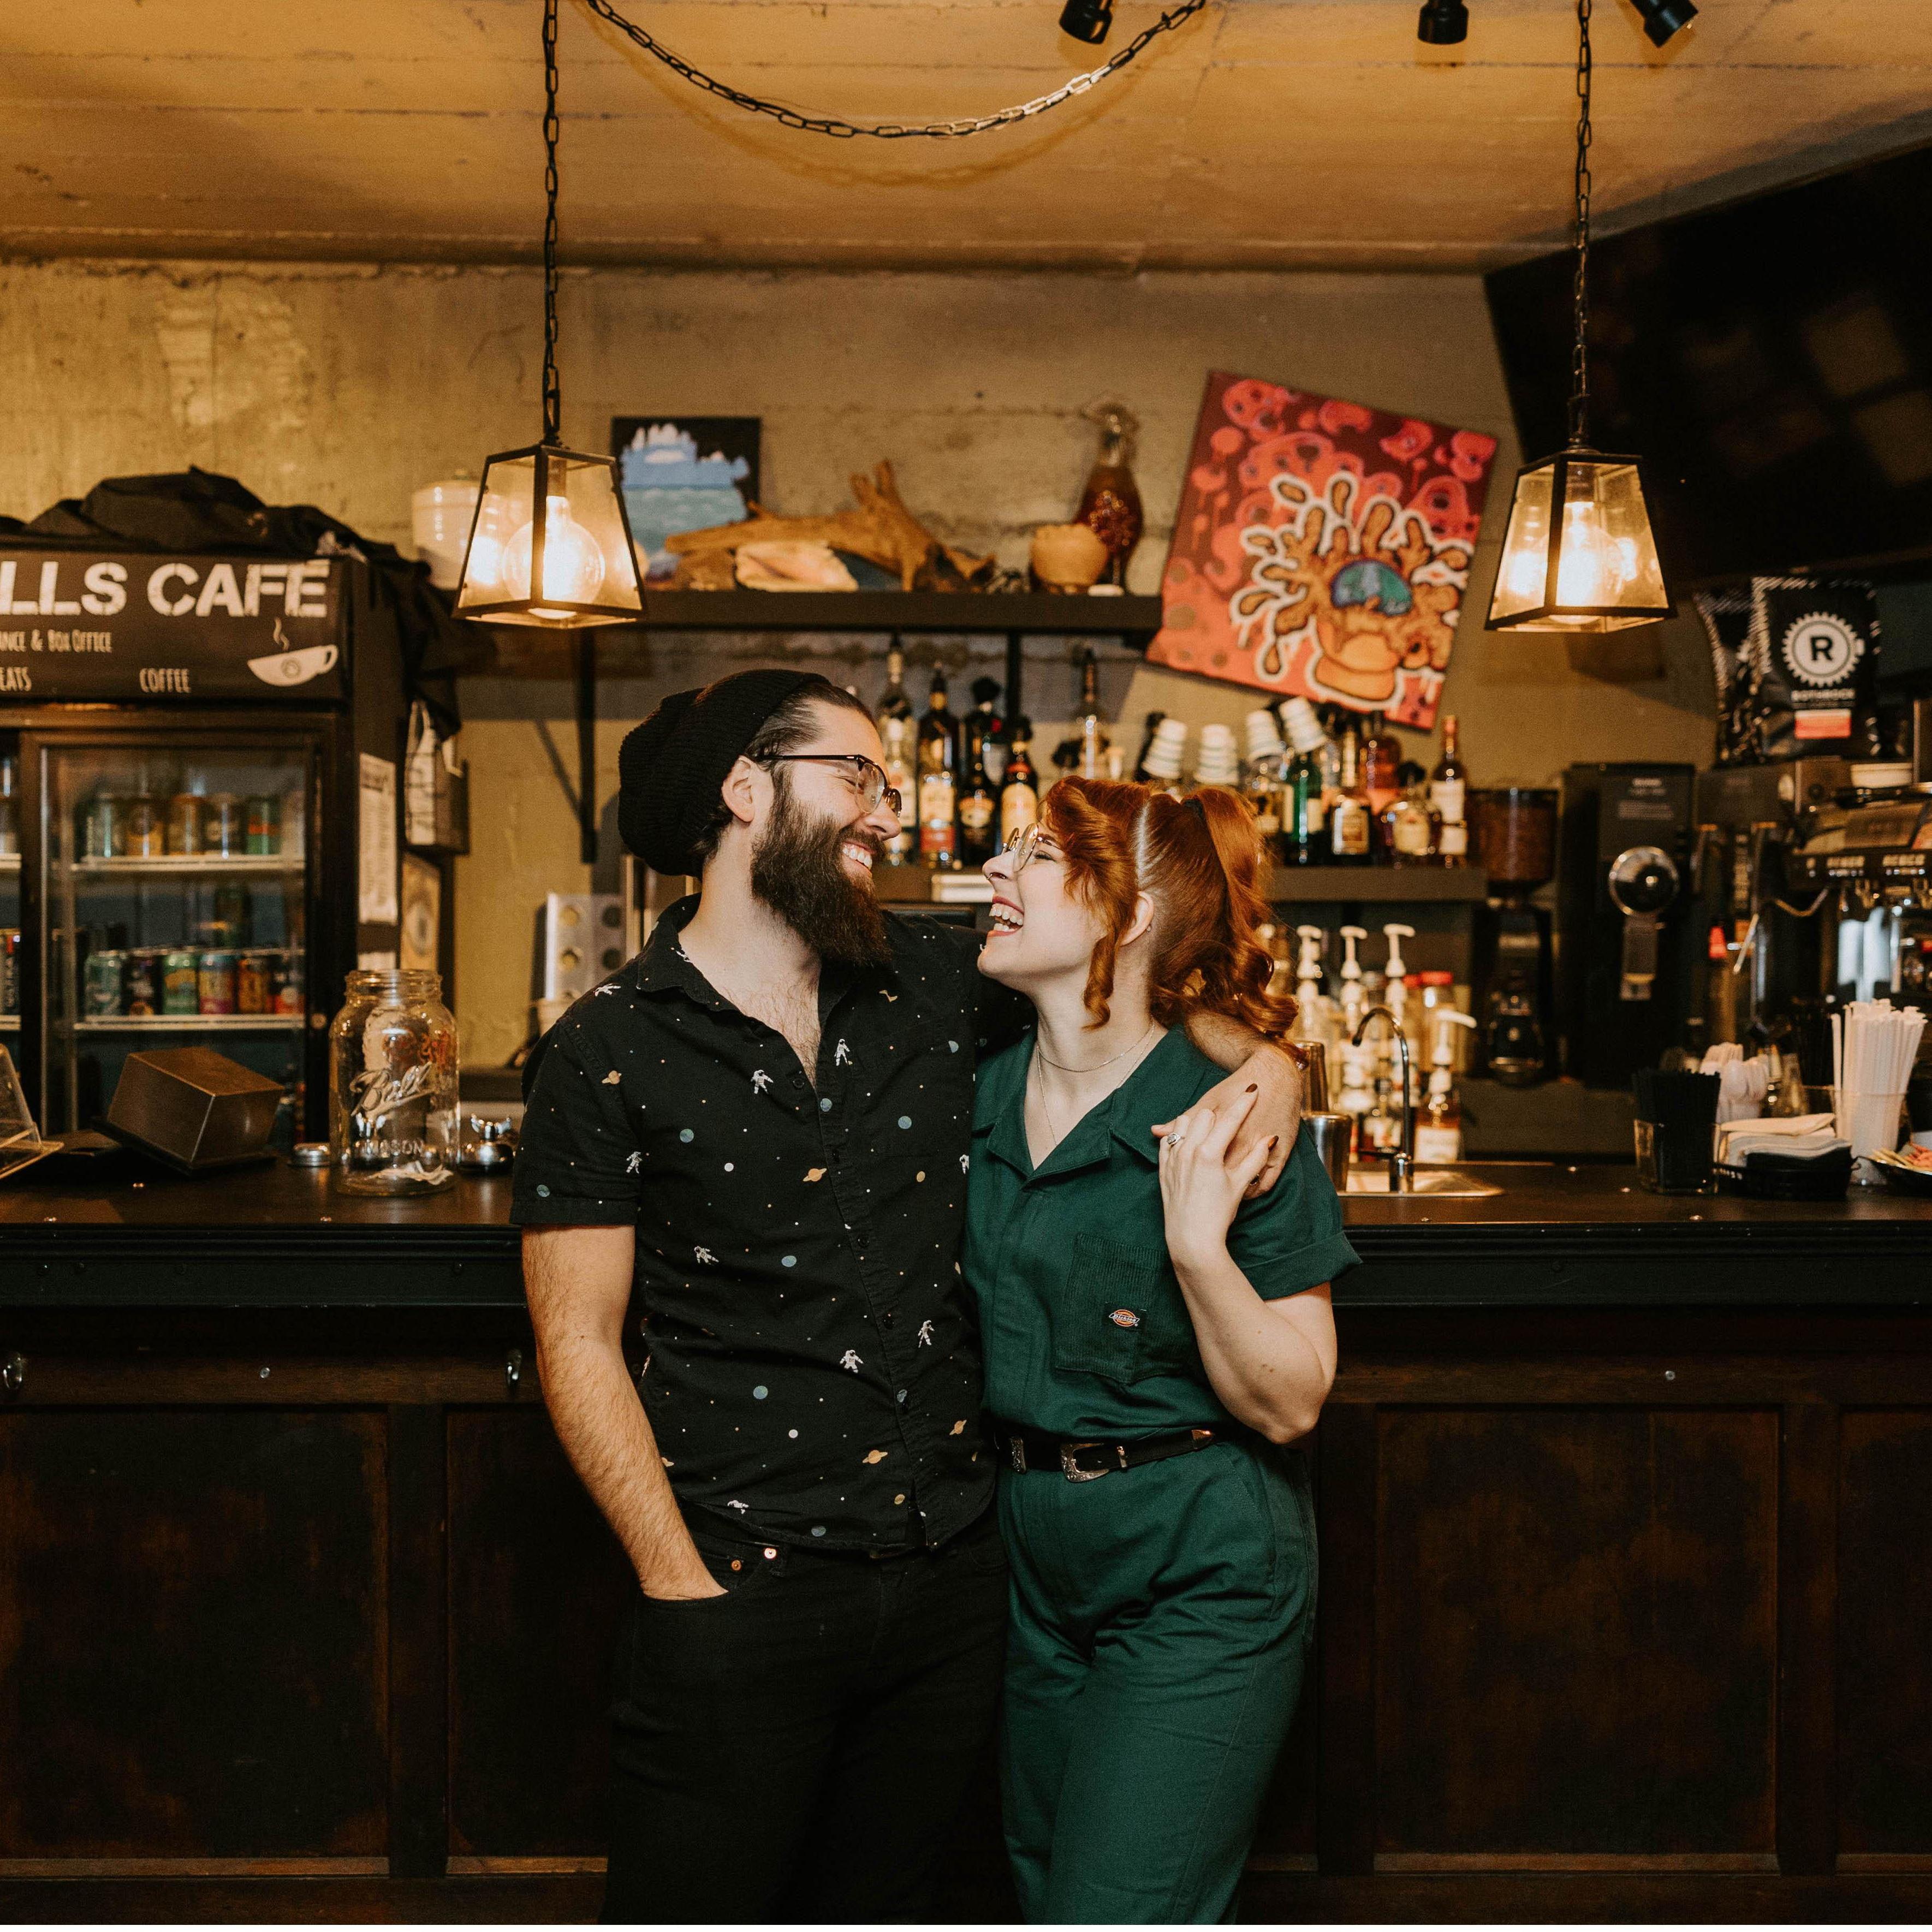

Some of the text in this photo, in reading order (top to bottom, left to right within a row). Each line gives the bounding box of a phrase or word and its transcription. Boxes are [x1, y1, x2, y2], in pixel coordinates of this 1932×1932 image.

[0, 561, 128, 616] LLS
[31, 629, 43, 652] &
[72, 629, 112, 653] OFFICE
[1810, 635, 1833, 661] R
[140, 668, 191, 693] COFFEE
[349, 1061, 436, 1117] Ball
